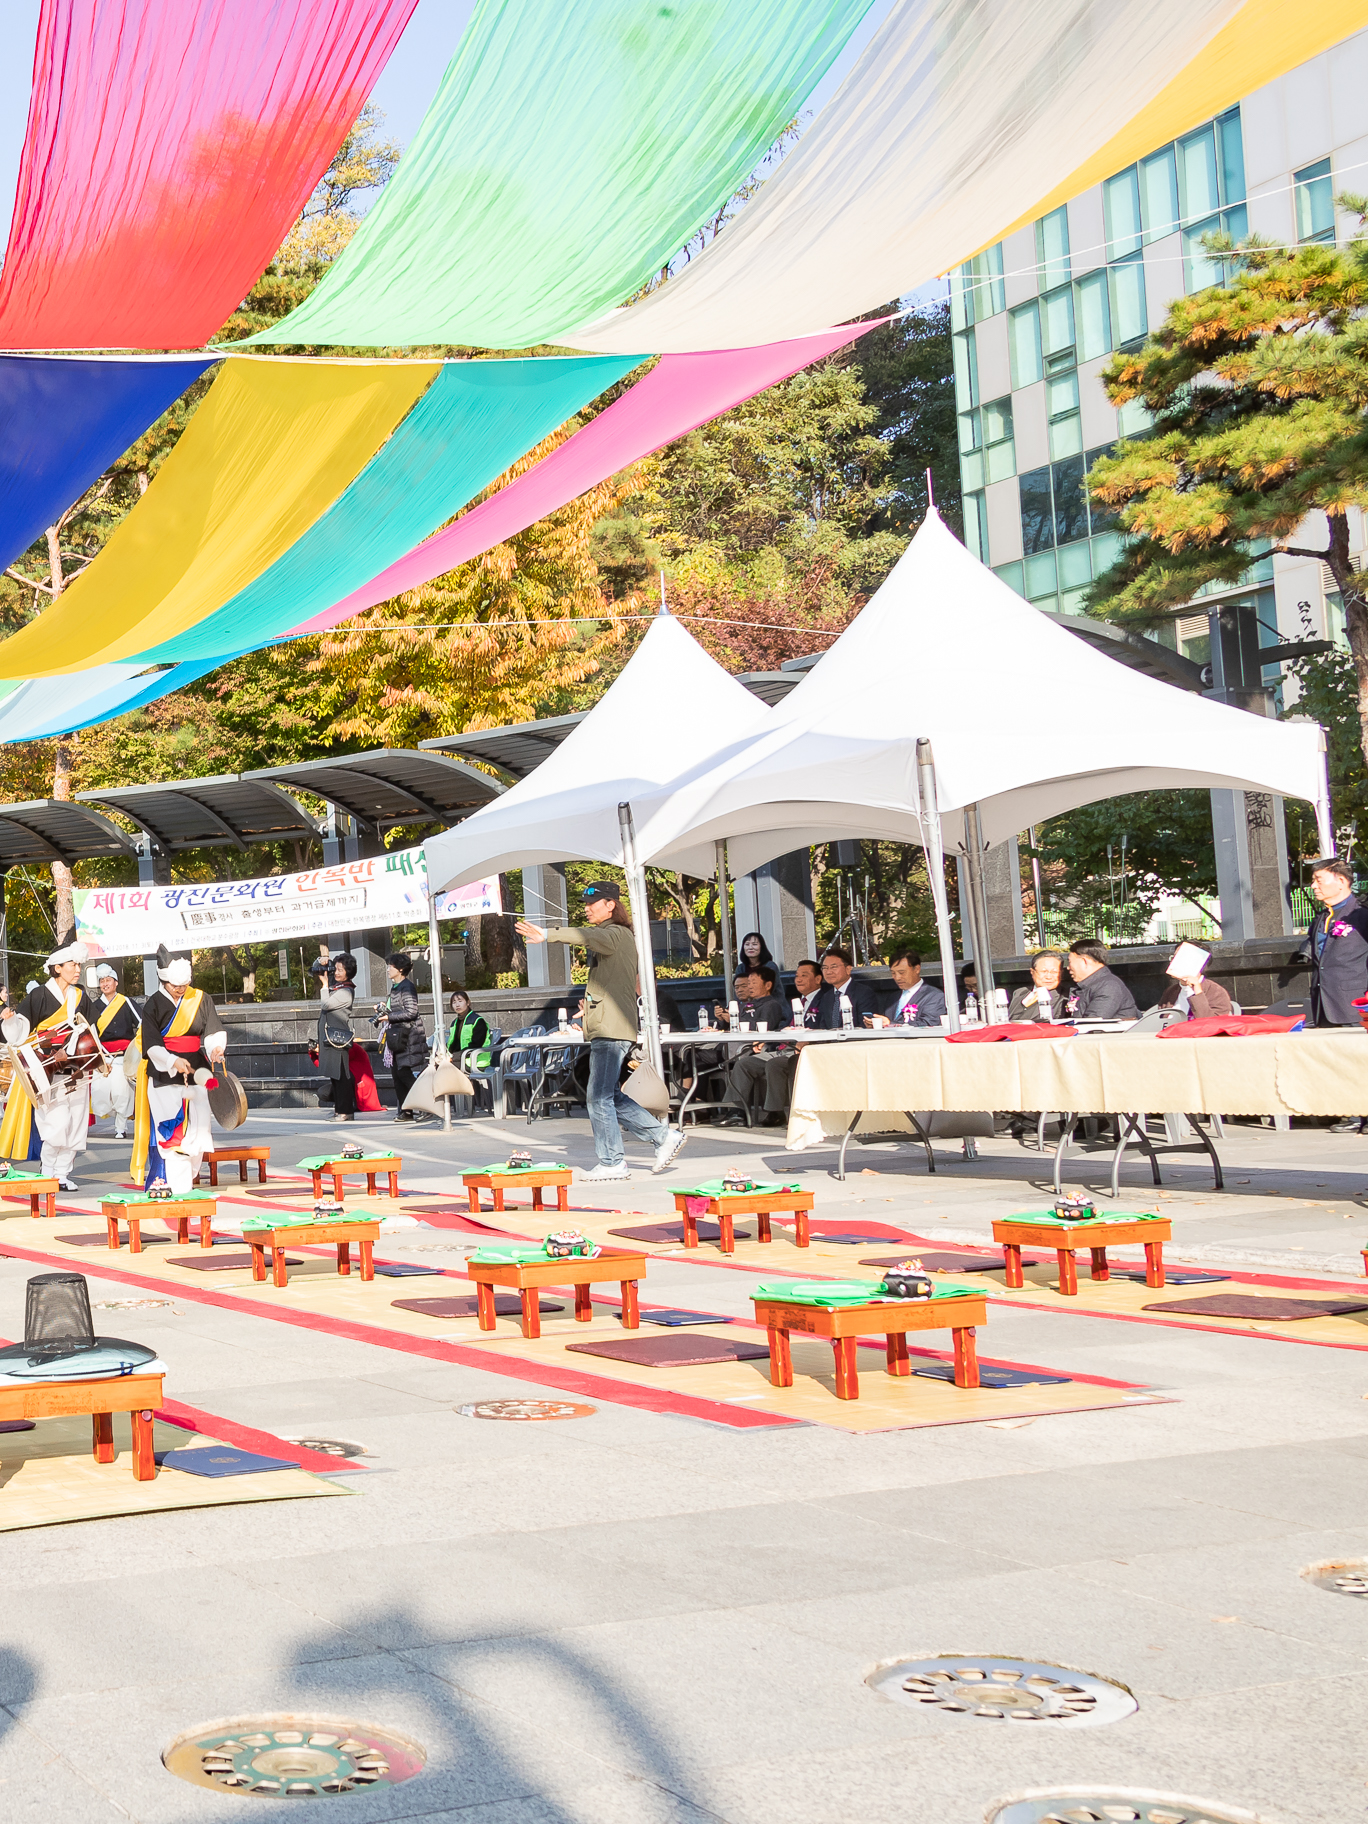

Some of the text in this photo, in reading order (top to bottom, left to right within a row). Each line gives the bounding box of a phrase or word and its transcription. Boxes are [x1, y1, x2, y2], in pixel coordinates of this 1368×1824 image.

[93, 891, 152, 914] 제1회
[160, 878, 287, 909] 광진문화원
[296, 860, 375, 892] 한복반
[241, 905, 285, 919] 출생부터
[291, 895, 359, 912] 과거급제까지
